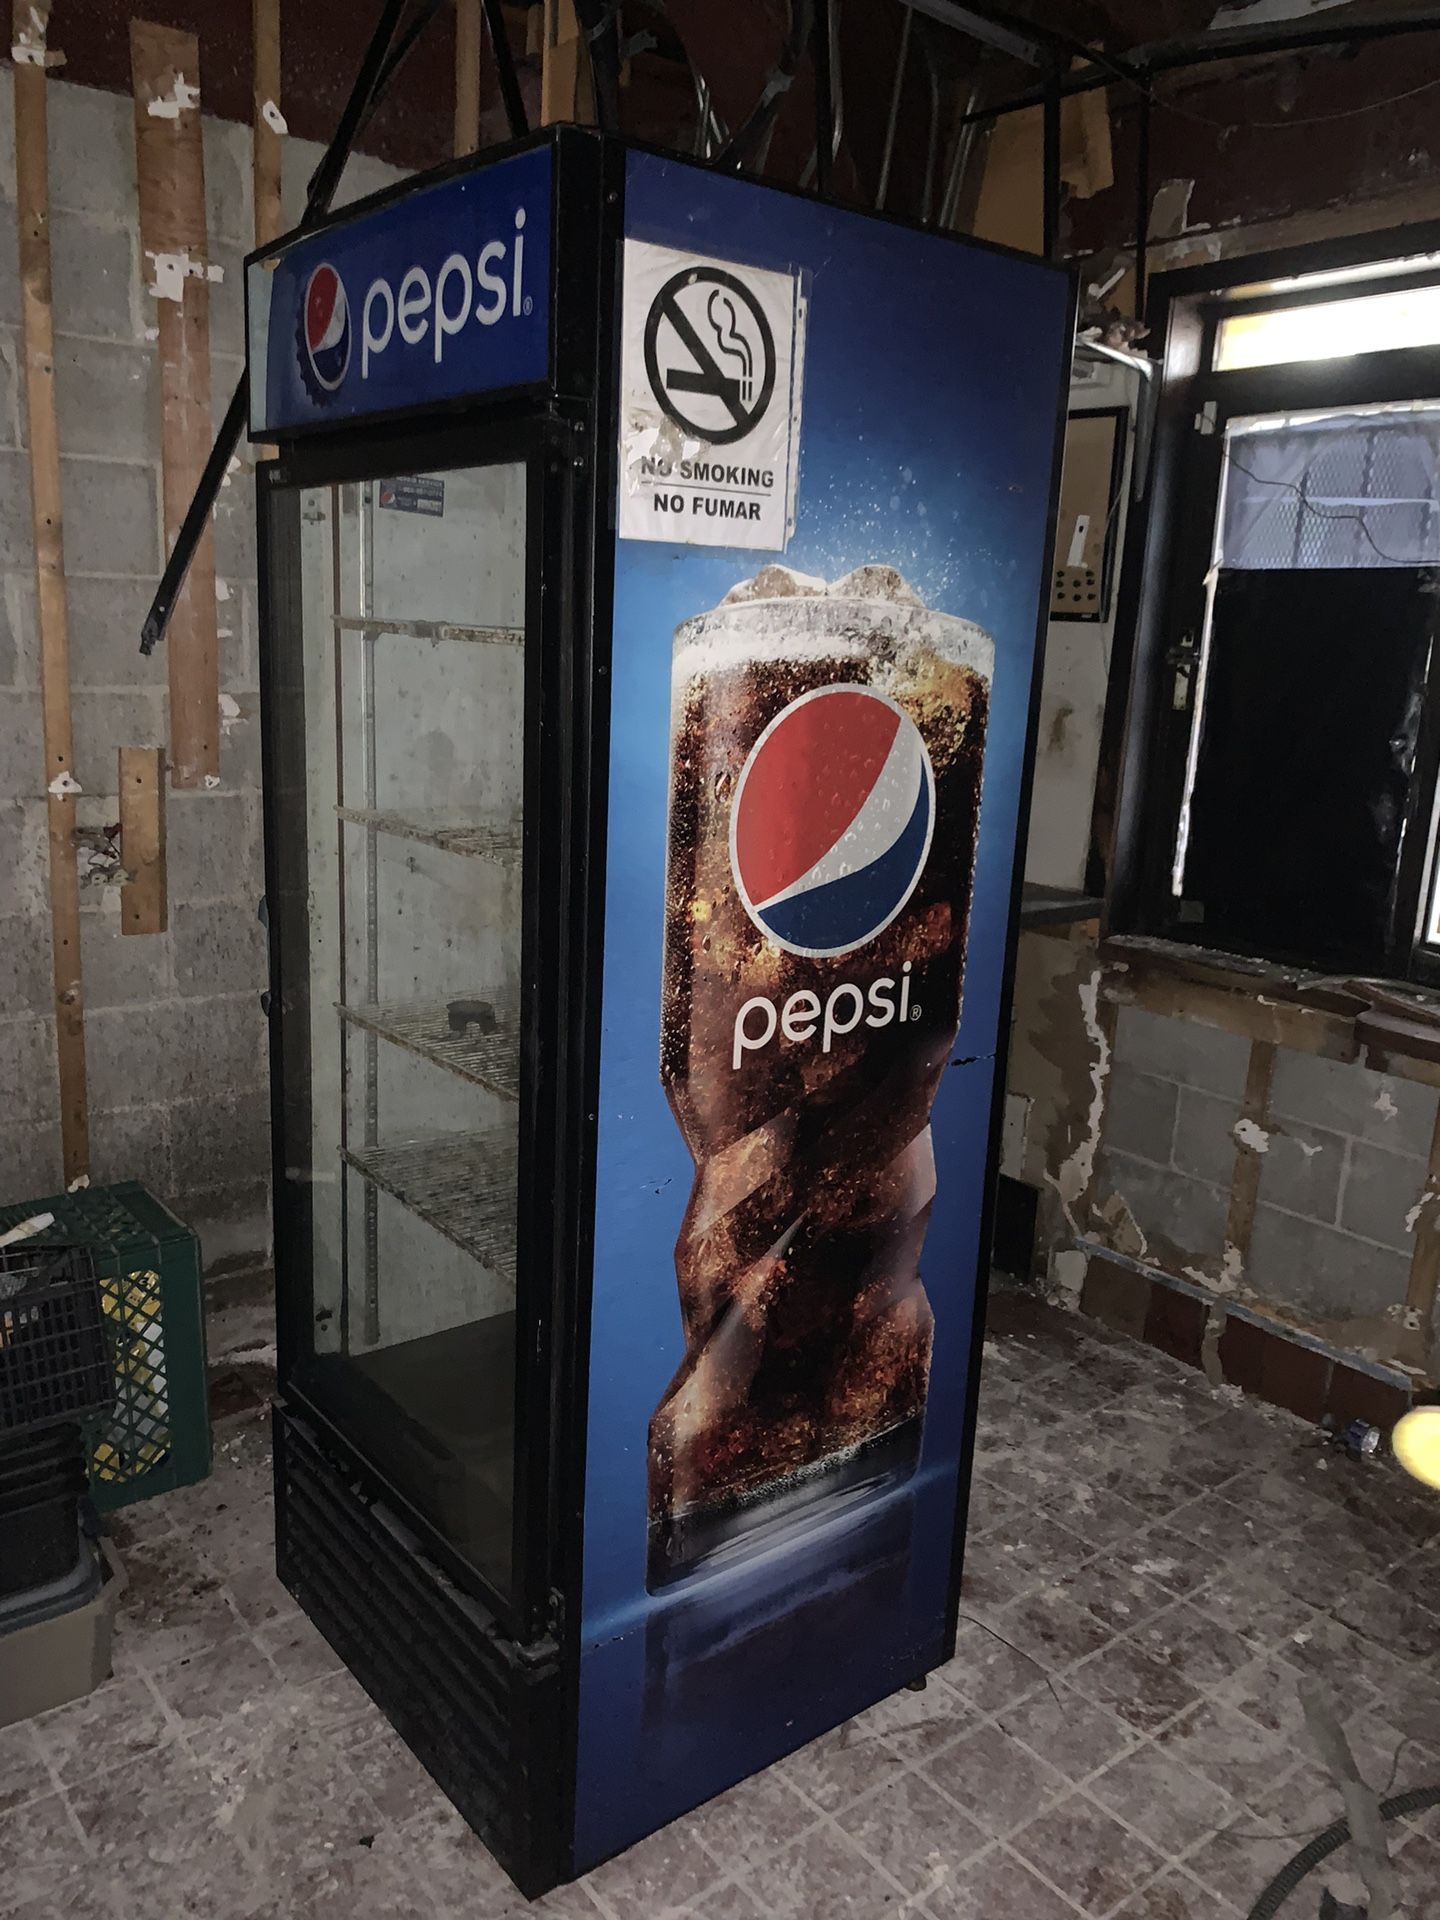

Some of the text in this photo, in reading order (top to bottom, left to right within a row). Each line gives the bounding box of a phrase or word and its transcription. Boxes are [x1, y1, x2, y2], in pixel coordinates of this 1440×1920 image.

[361, 207, 527, 380] pepsi
[641, 456, 774, 488] NO SMOKING
[653, 493, 761, 521] NO FUMAR
[732, 960, 913, 1070] pepsi
